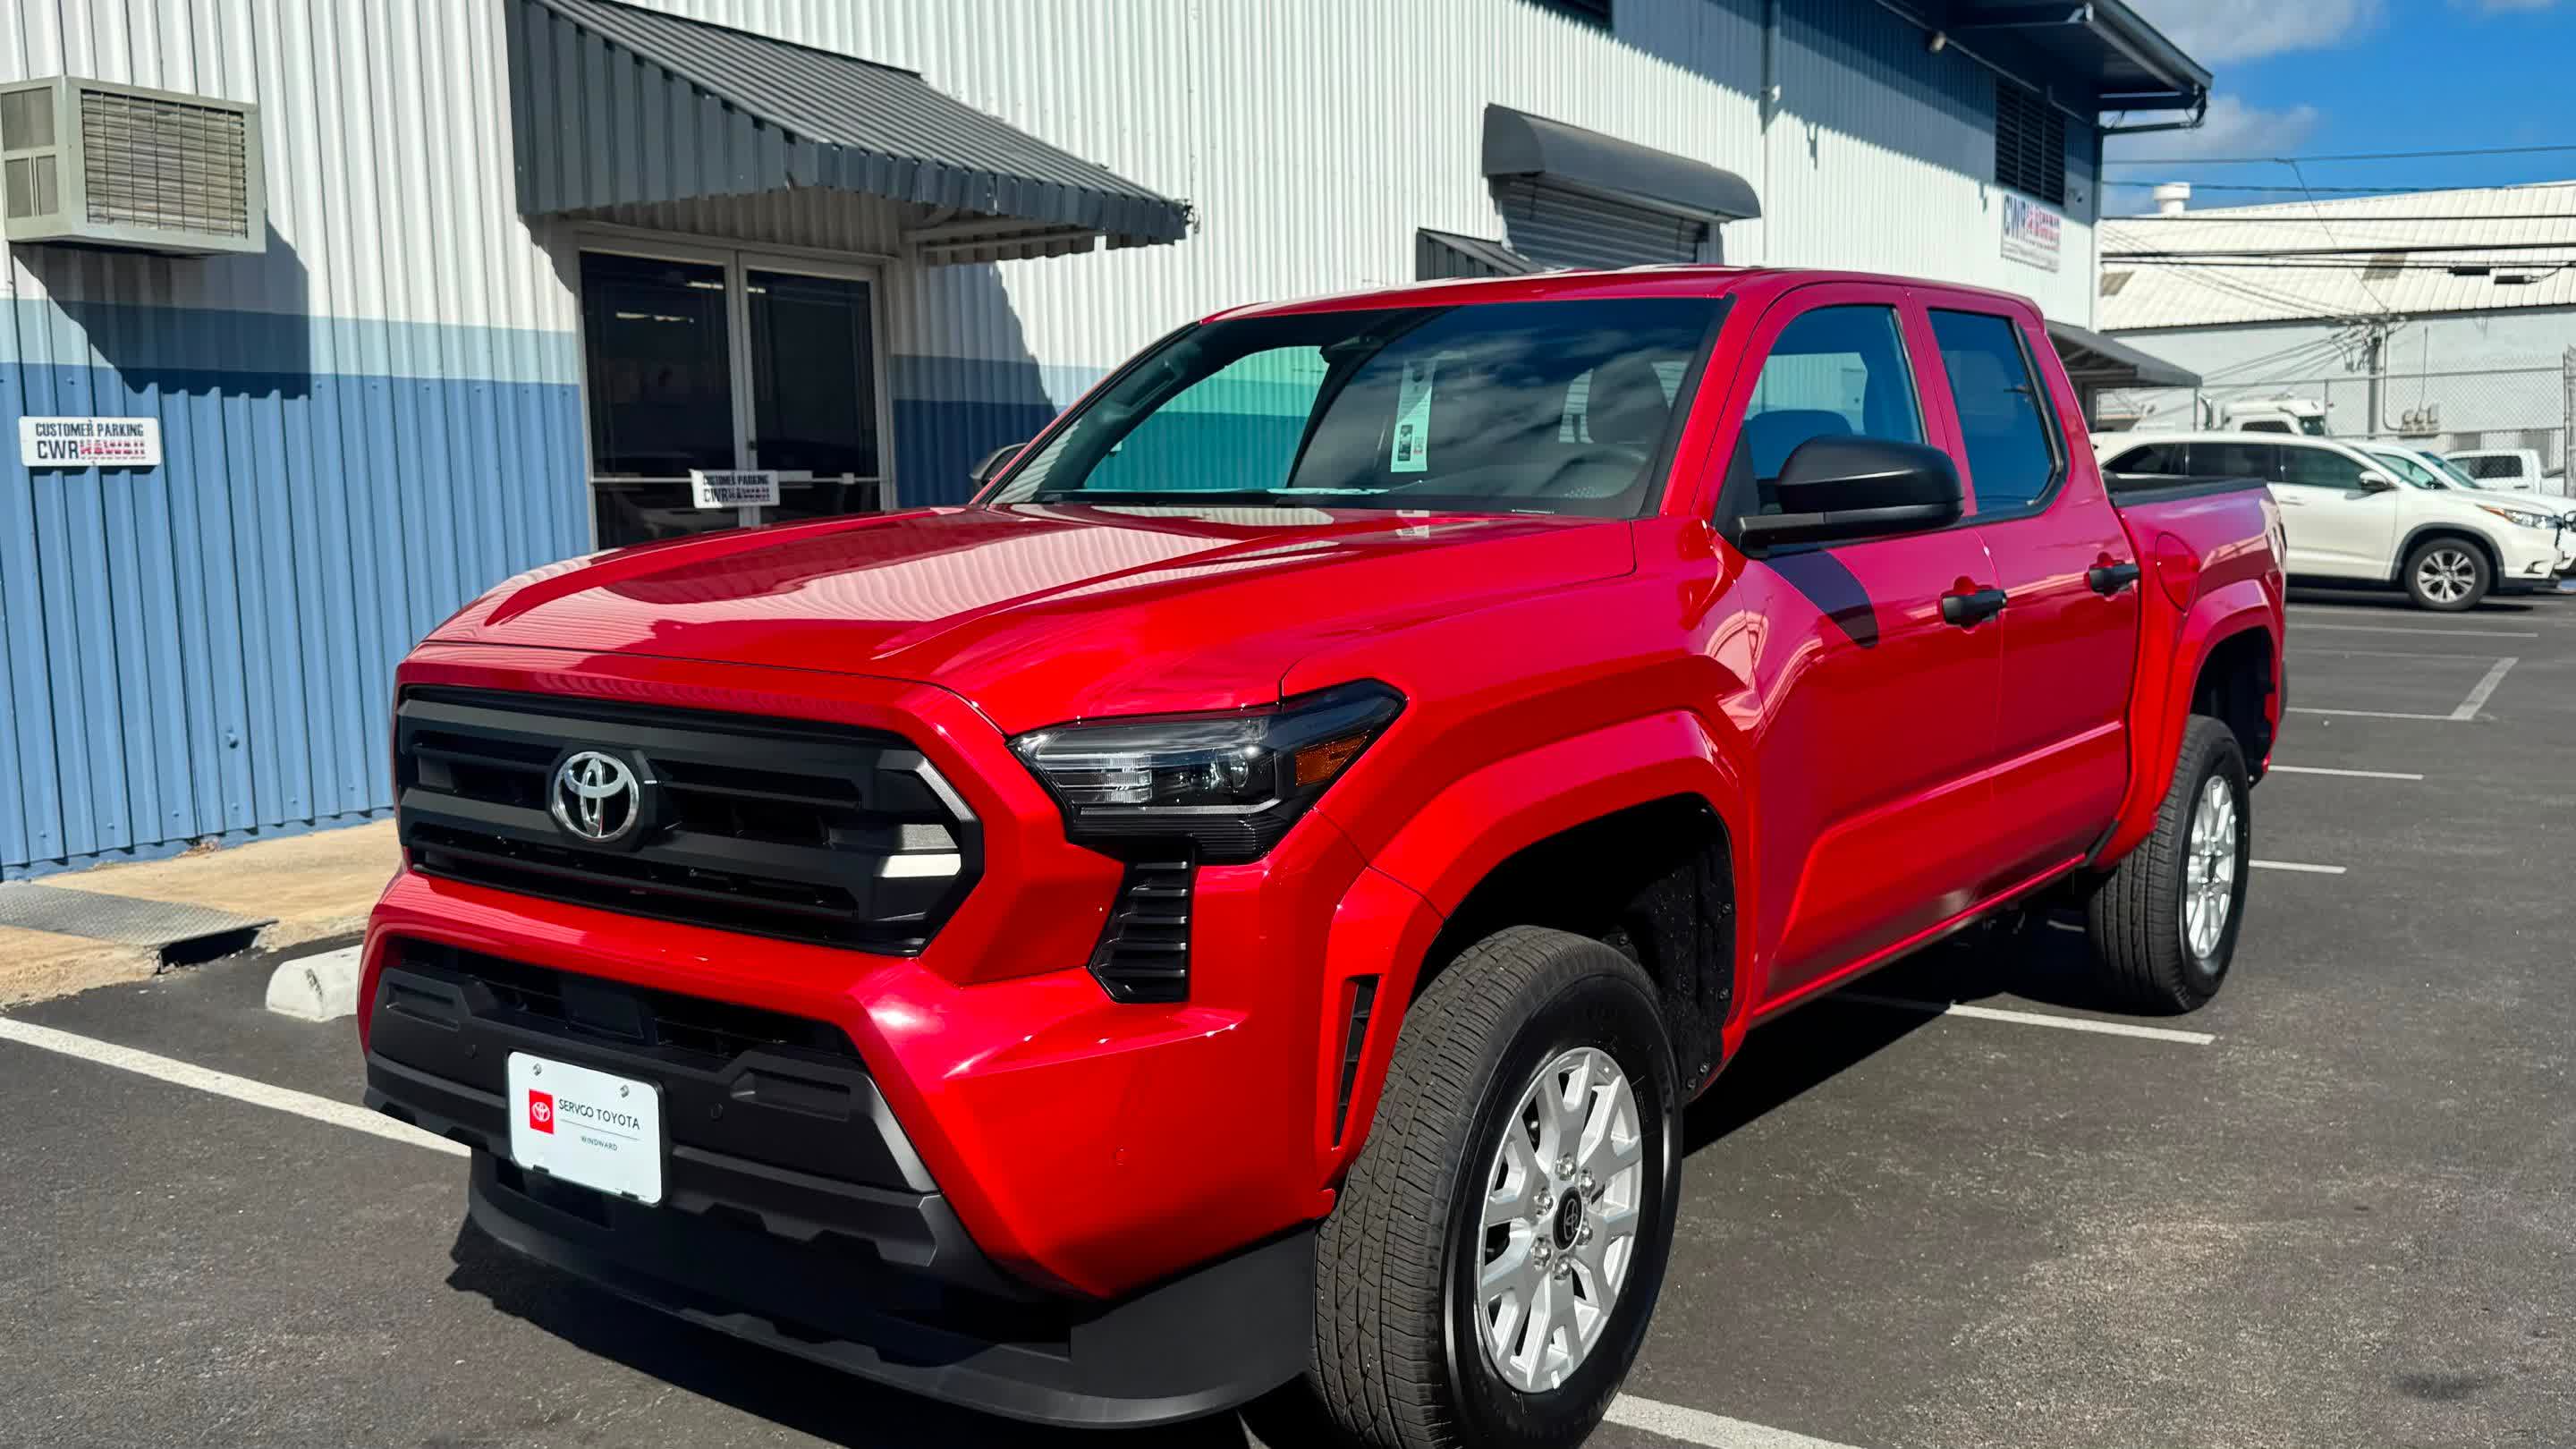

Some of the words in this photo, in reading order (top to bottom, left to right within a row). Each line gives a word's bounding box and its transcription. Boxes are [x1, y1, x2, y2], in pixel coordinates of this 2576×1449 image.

[35, 422, 94, 436] CUSTOMER
[97, 422, 144, 436] PARKING
[558, 1098, 594, 1118] SERVCO
[597, 1108, 640, 1130] TOYOTA
[581, 1136, 618, 1151] WINDWARD
